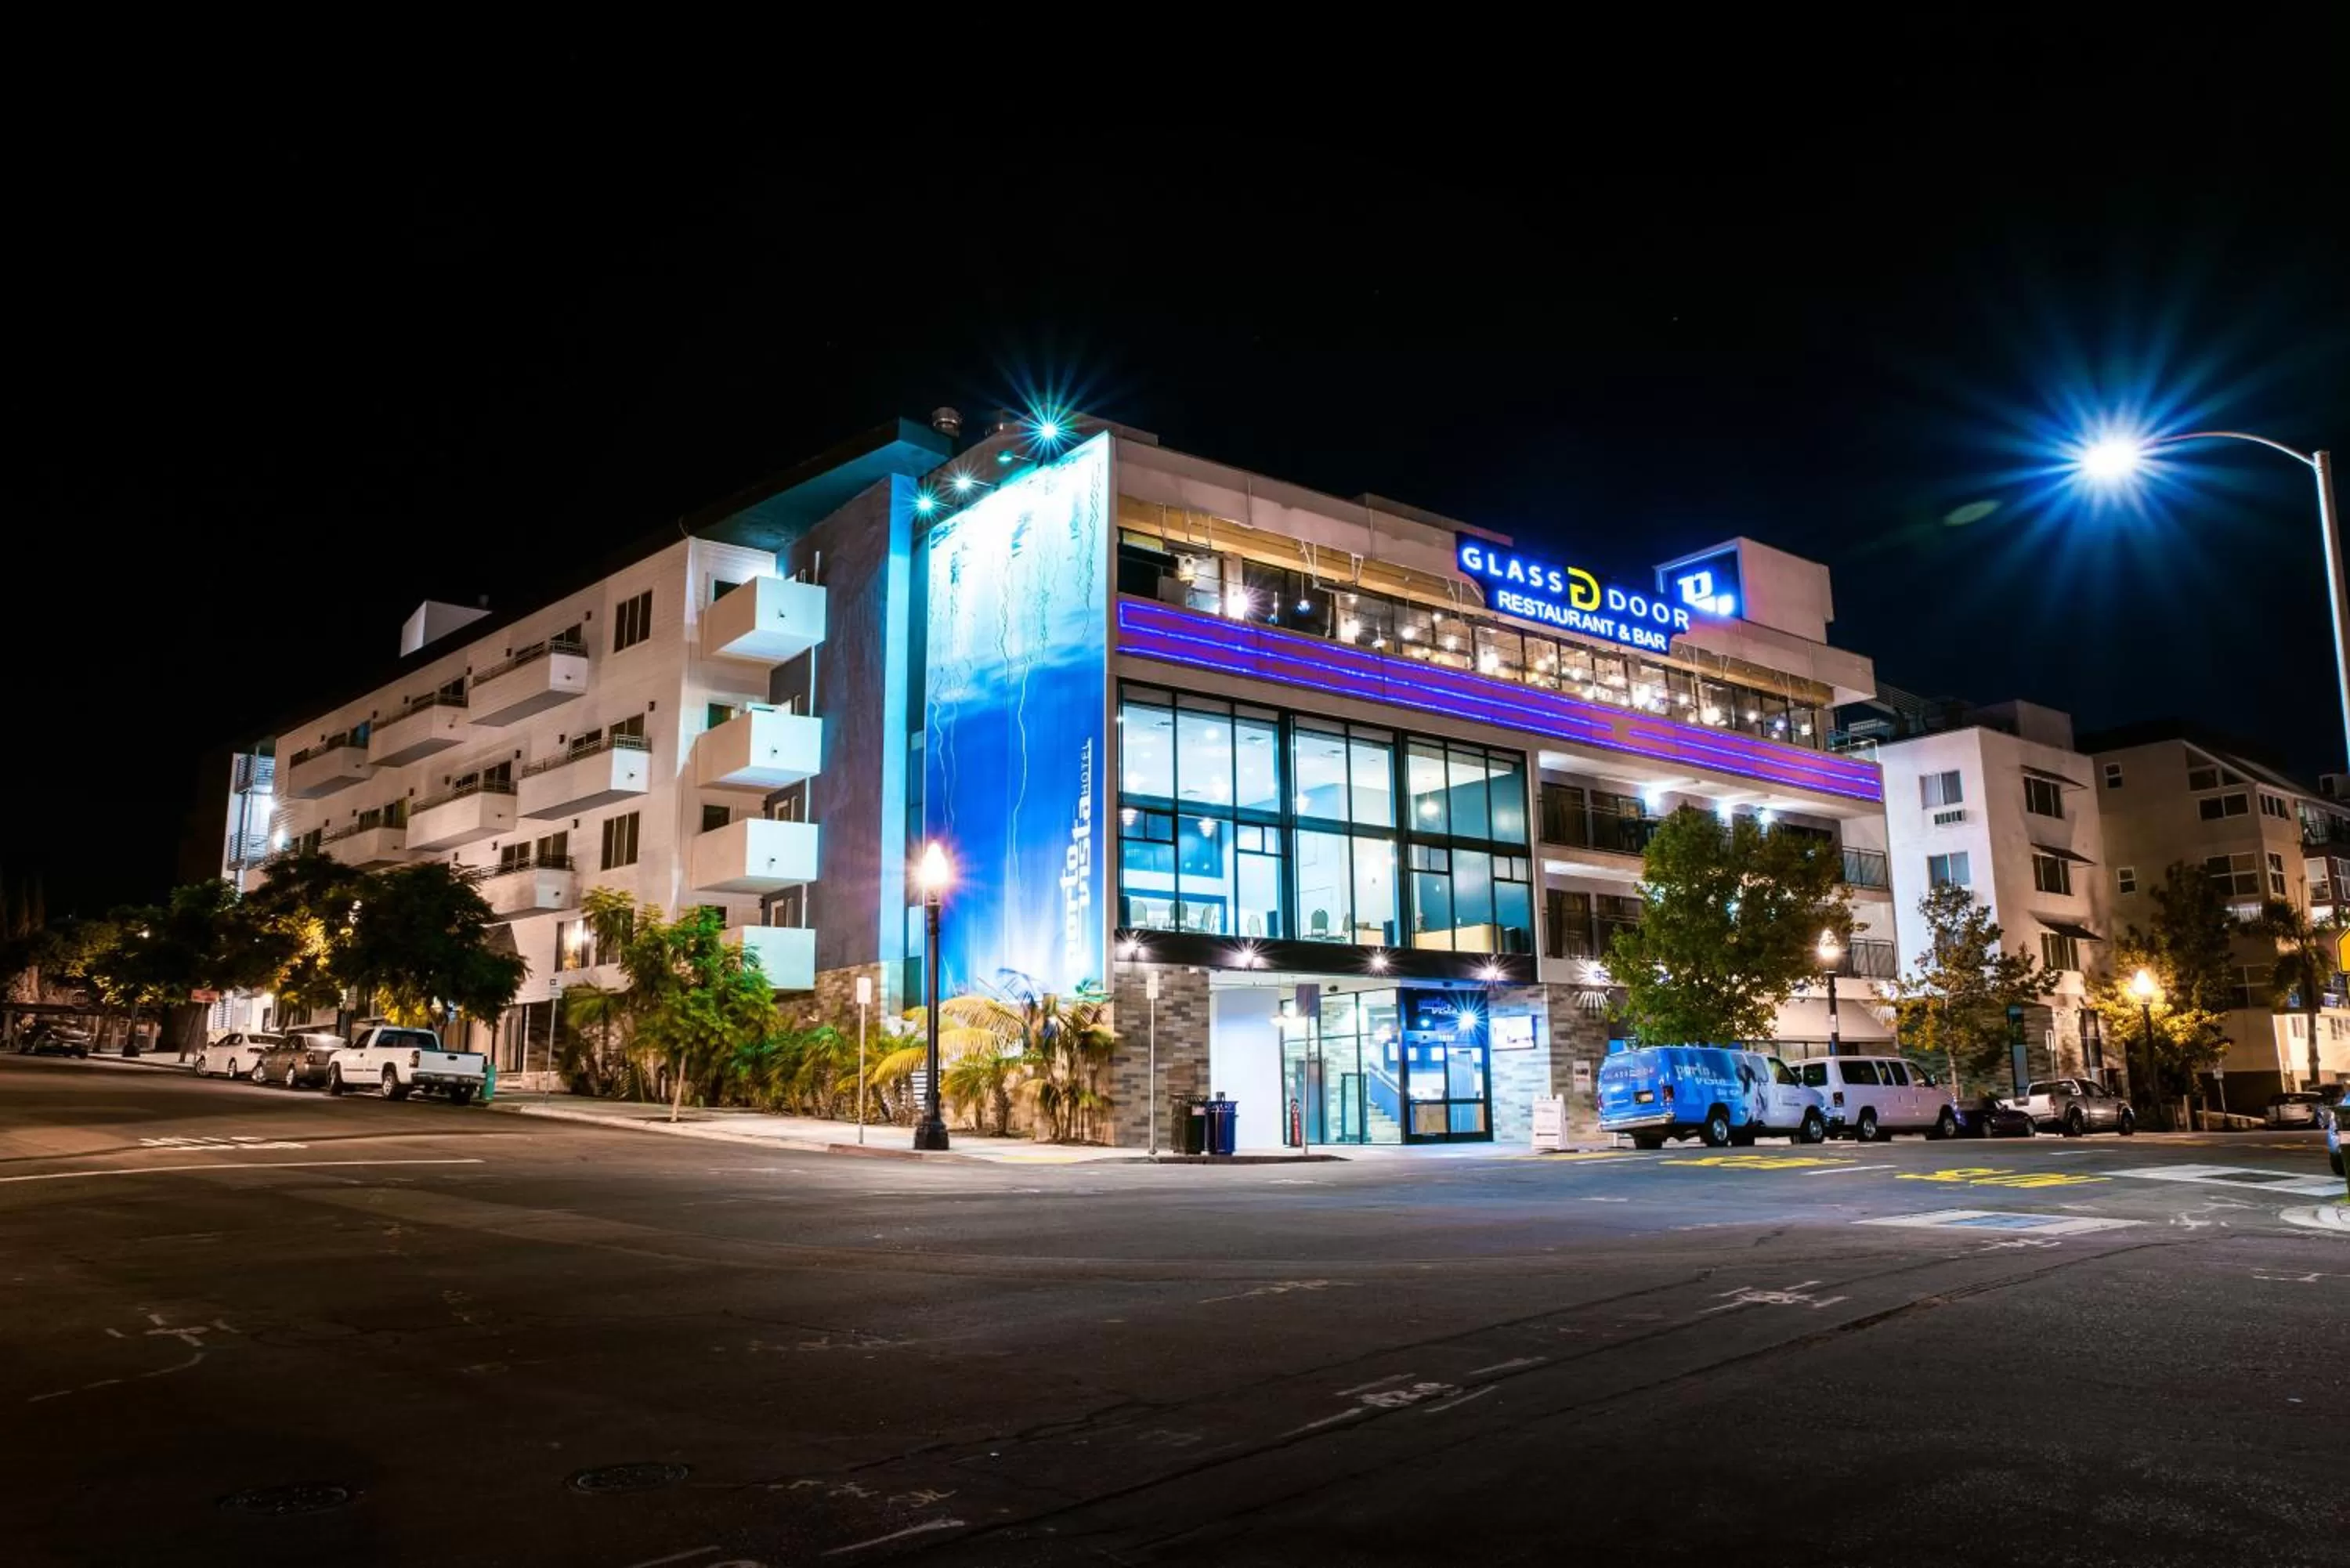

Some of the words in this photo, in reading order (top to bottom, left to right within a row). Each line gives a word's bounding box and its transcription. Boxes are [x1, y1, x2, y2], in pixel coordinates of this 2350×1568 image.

[1462, 547, 1564, 593] GLASS
[1608, 587, 1690, 631] DOOR
[1498, 591, 1614, 638] RESTAURANT
[1619, 623, 1632, 641] &
[1633, 627, 1667, 651] BAR
[1080, 738, 1090, 795] HOTEL
[1072, 796, 1090, 907] vista
